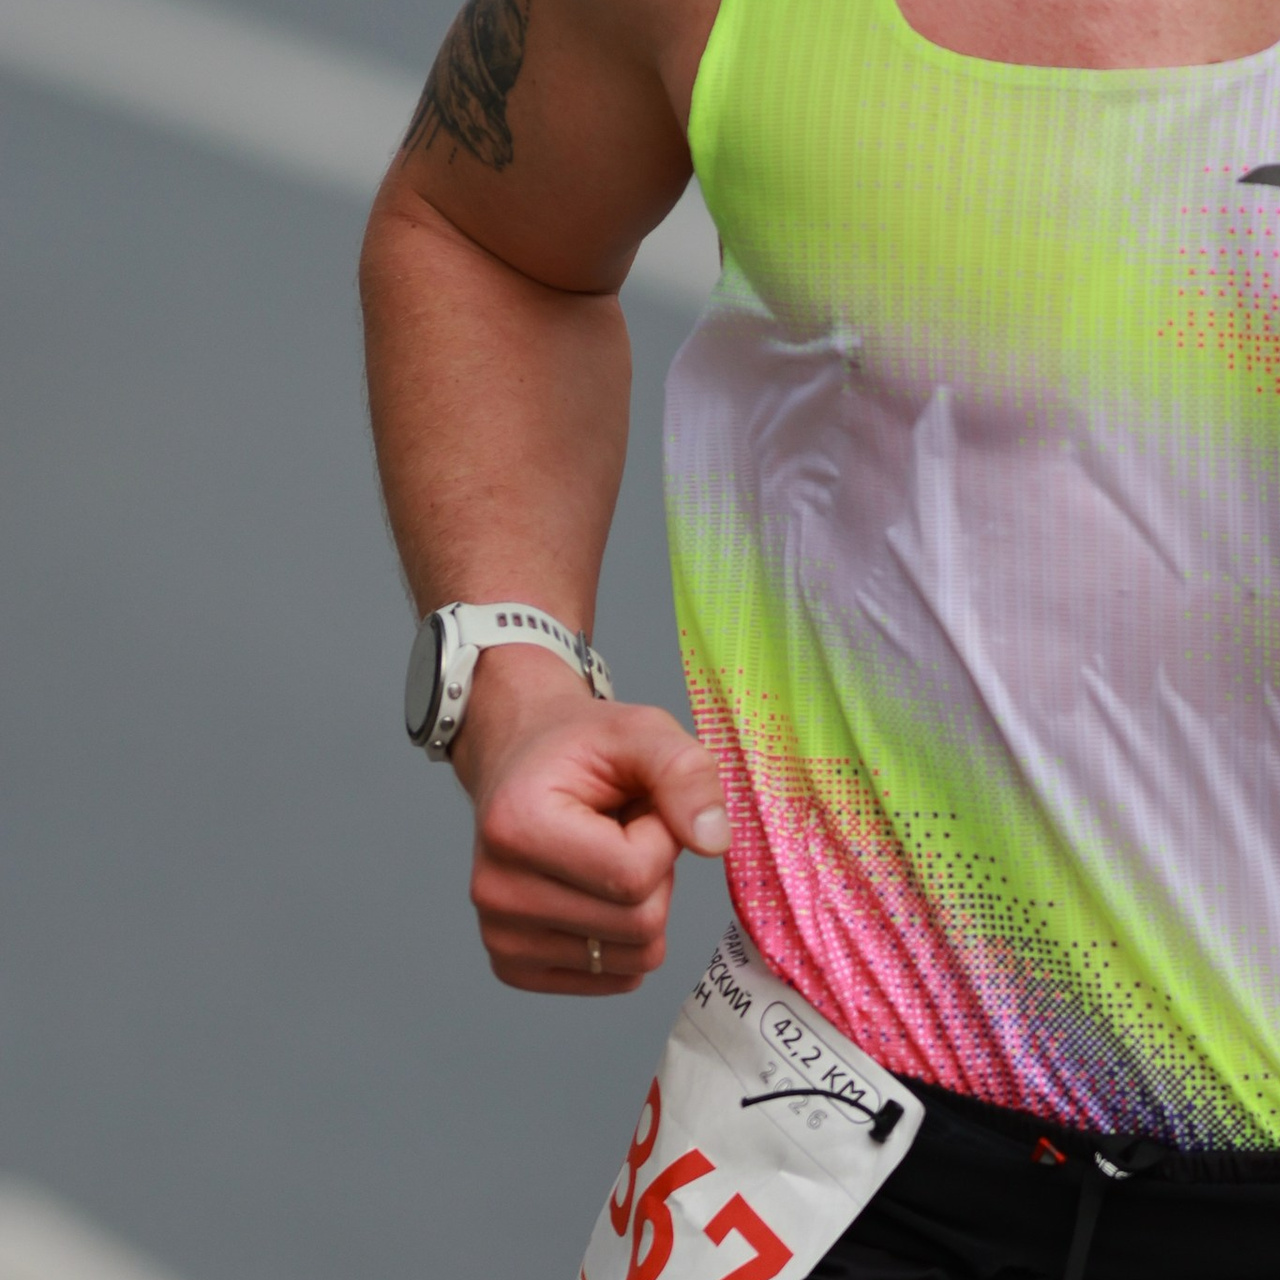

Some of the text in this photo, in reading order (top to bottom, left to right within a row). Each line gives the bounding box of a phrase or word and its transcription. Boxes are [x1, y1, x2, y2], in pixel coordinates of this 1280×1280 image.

[693, 980, 712, 1008] Н
[706, 947, 752, 1018] РСКИЙ
[773, 1019, 822, 1069] 42,2
[760, 1061, 828, 1130] 2026
